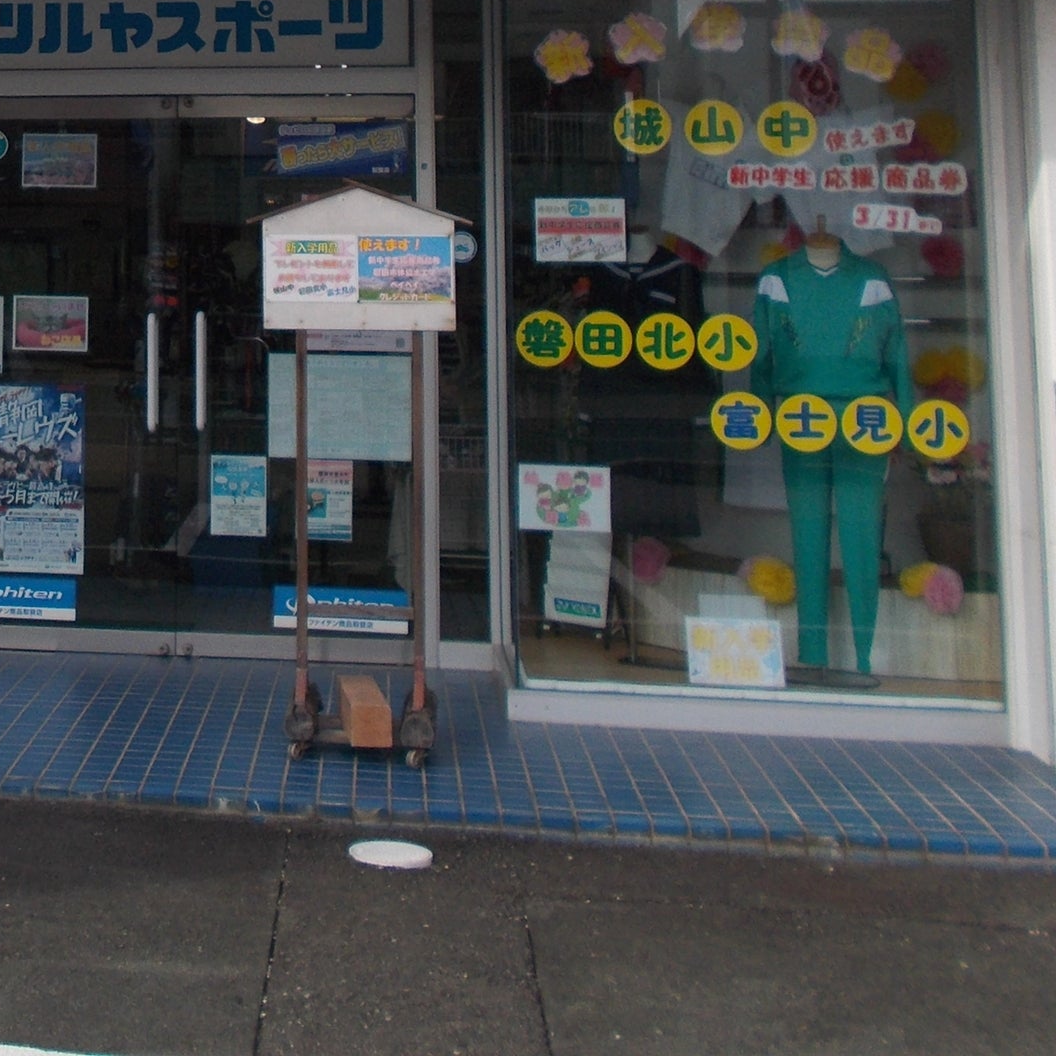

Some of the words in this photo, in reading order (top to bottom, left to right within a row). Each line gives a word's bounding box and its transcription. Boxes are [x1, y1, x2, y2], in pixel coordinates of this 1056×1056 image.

[619, 105, 810, 148] 城山中
[729, 165, 814, 188] 新中学生
[521, 319, 753, 361] 磐田北小
[718, 402, 963, 451] 富士見小
